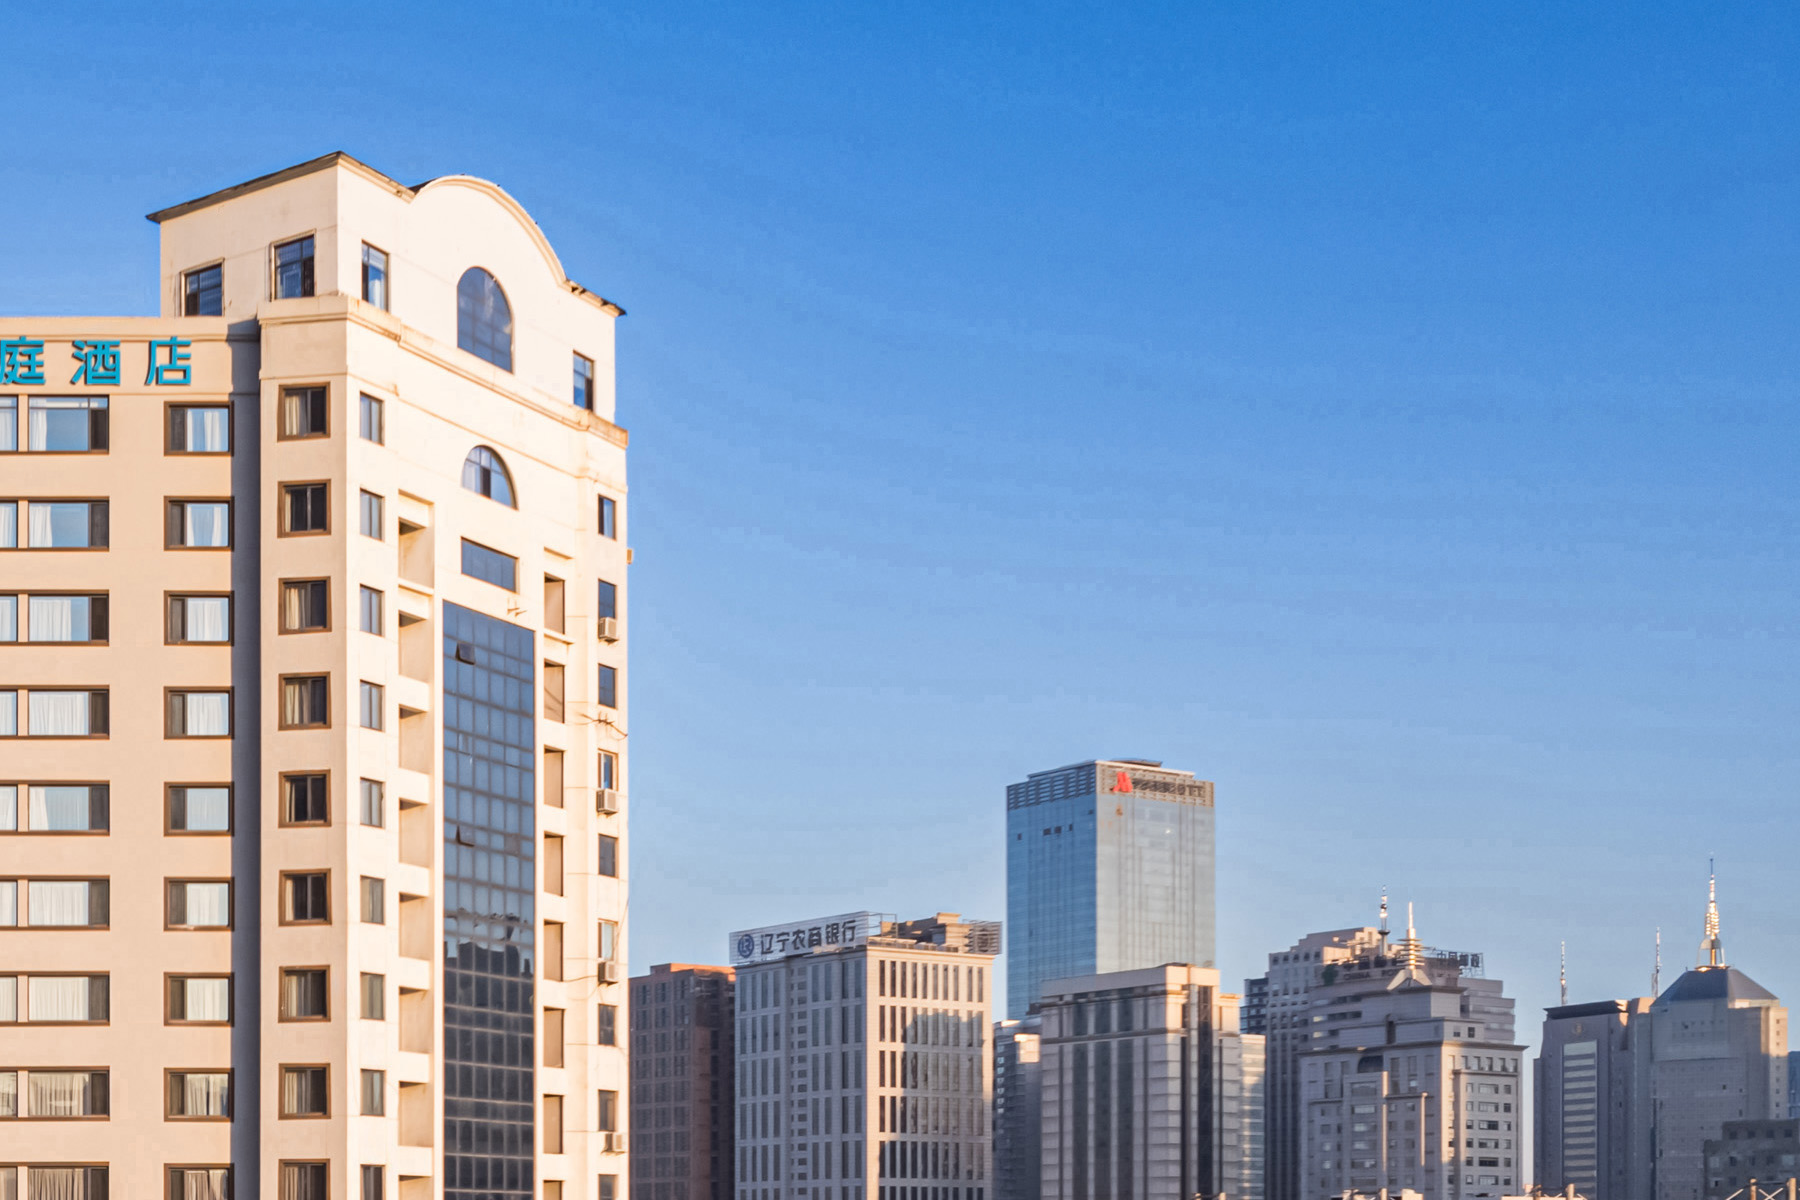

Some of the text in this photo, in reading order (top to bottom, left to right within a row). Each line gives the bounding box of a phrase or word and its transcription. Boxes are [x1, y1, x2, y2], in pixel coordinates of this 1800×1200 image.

[761, 920, 856, 954] 辽宁农商银行
